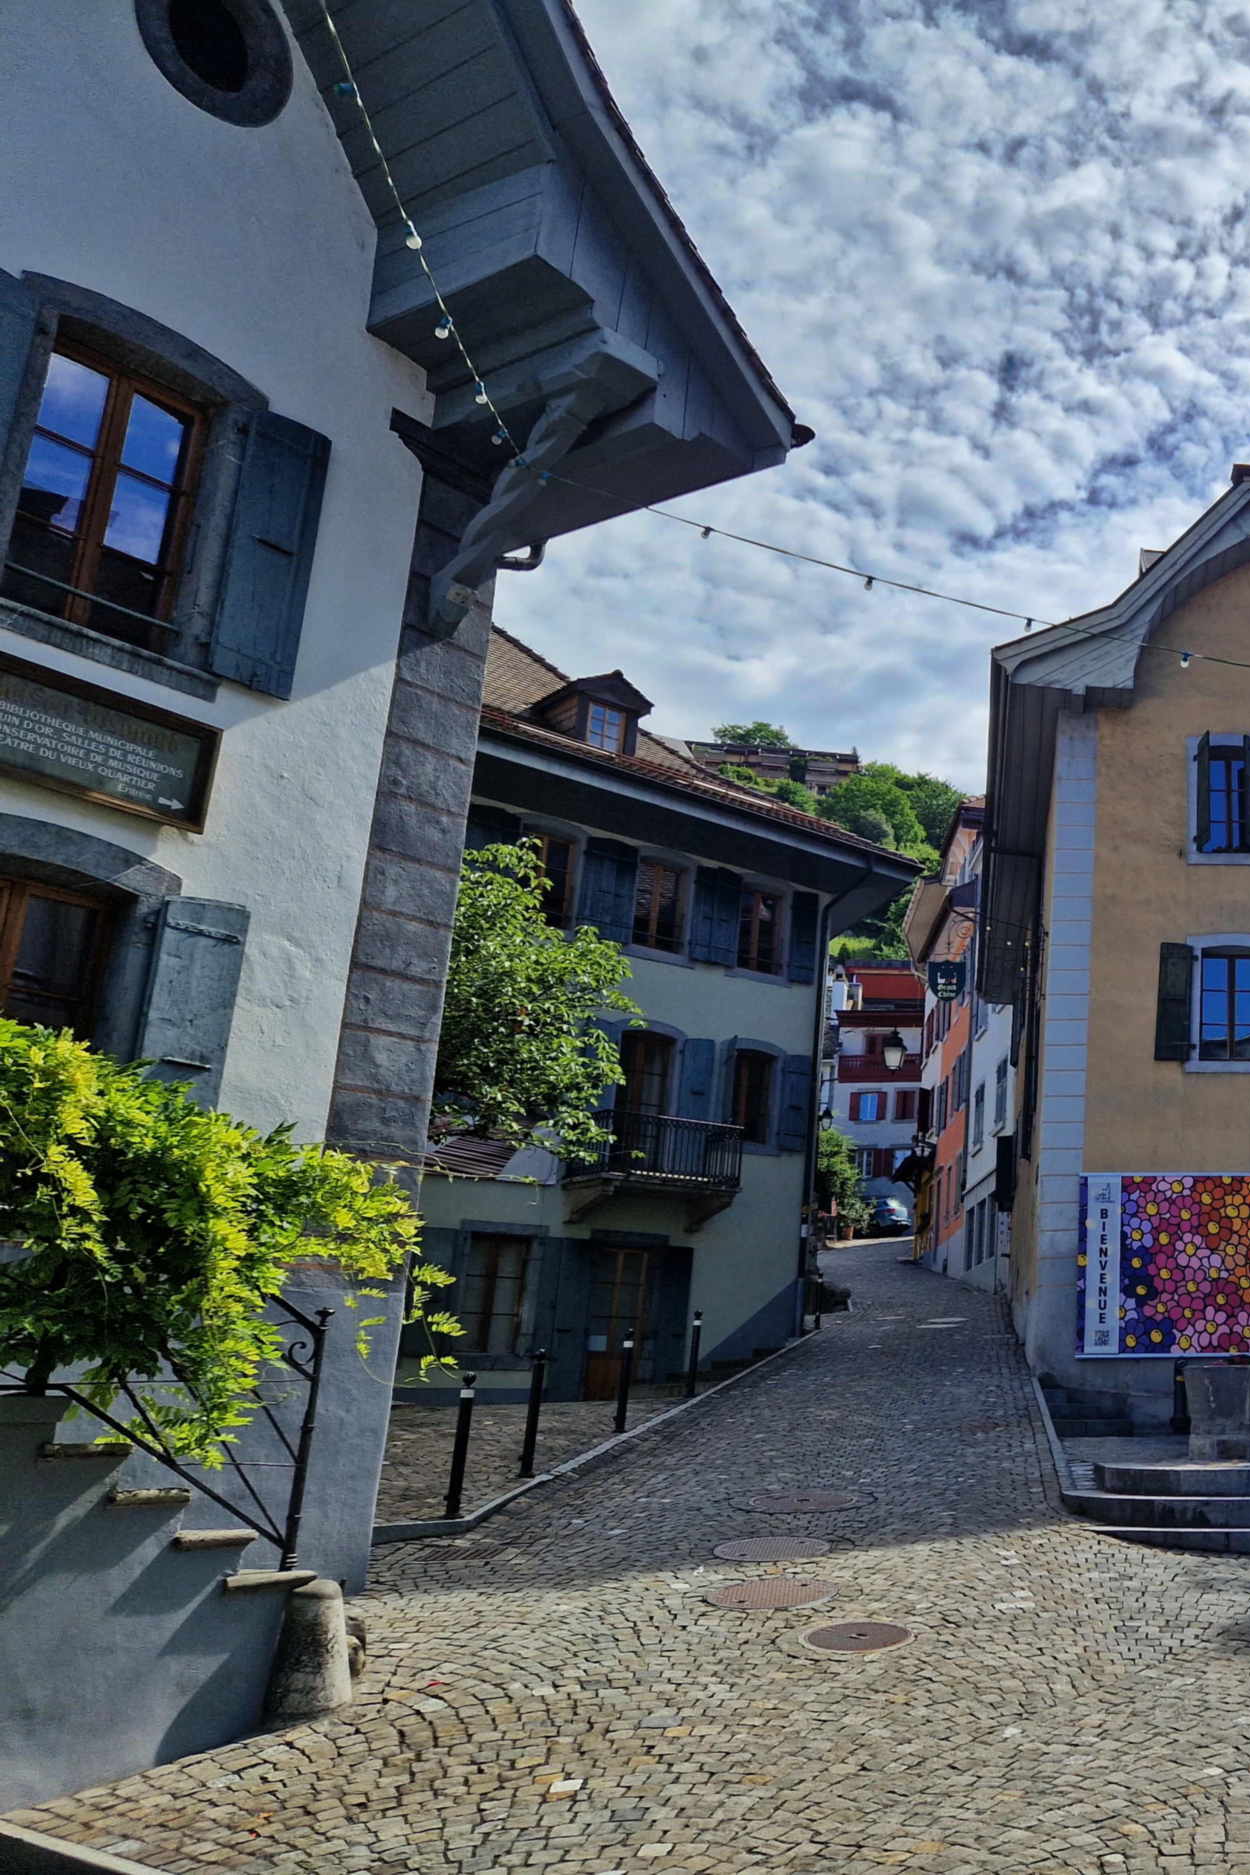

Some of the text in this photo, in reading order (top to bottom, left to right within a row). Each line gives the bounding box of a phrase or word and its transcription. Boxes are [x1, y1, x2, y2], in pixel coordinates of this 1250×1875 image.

[63, 732, 105, 753] SALLES
[109, 747, 124, 760] DE
[88, 730, 155, 759] MUNICIPALE
[40, 747, 57, 760] DU
[60, 753, 96, 772] VIEUX
[98, 766, 156, 791] QUARTIER
[90, 752, 105, 764] DE
[108, 759, 160, 782] MUSIQUE
[1098, 1208, 1109, 1324] BIENVENUE
